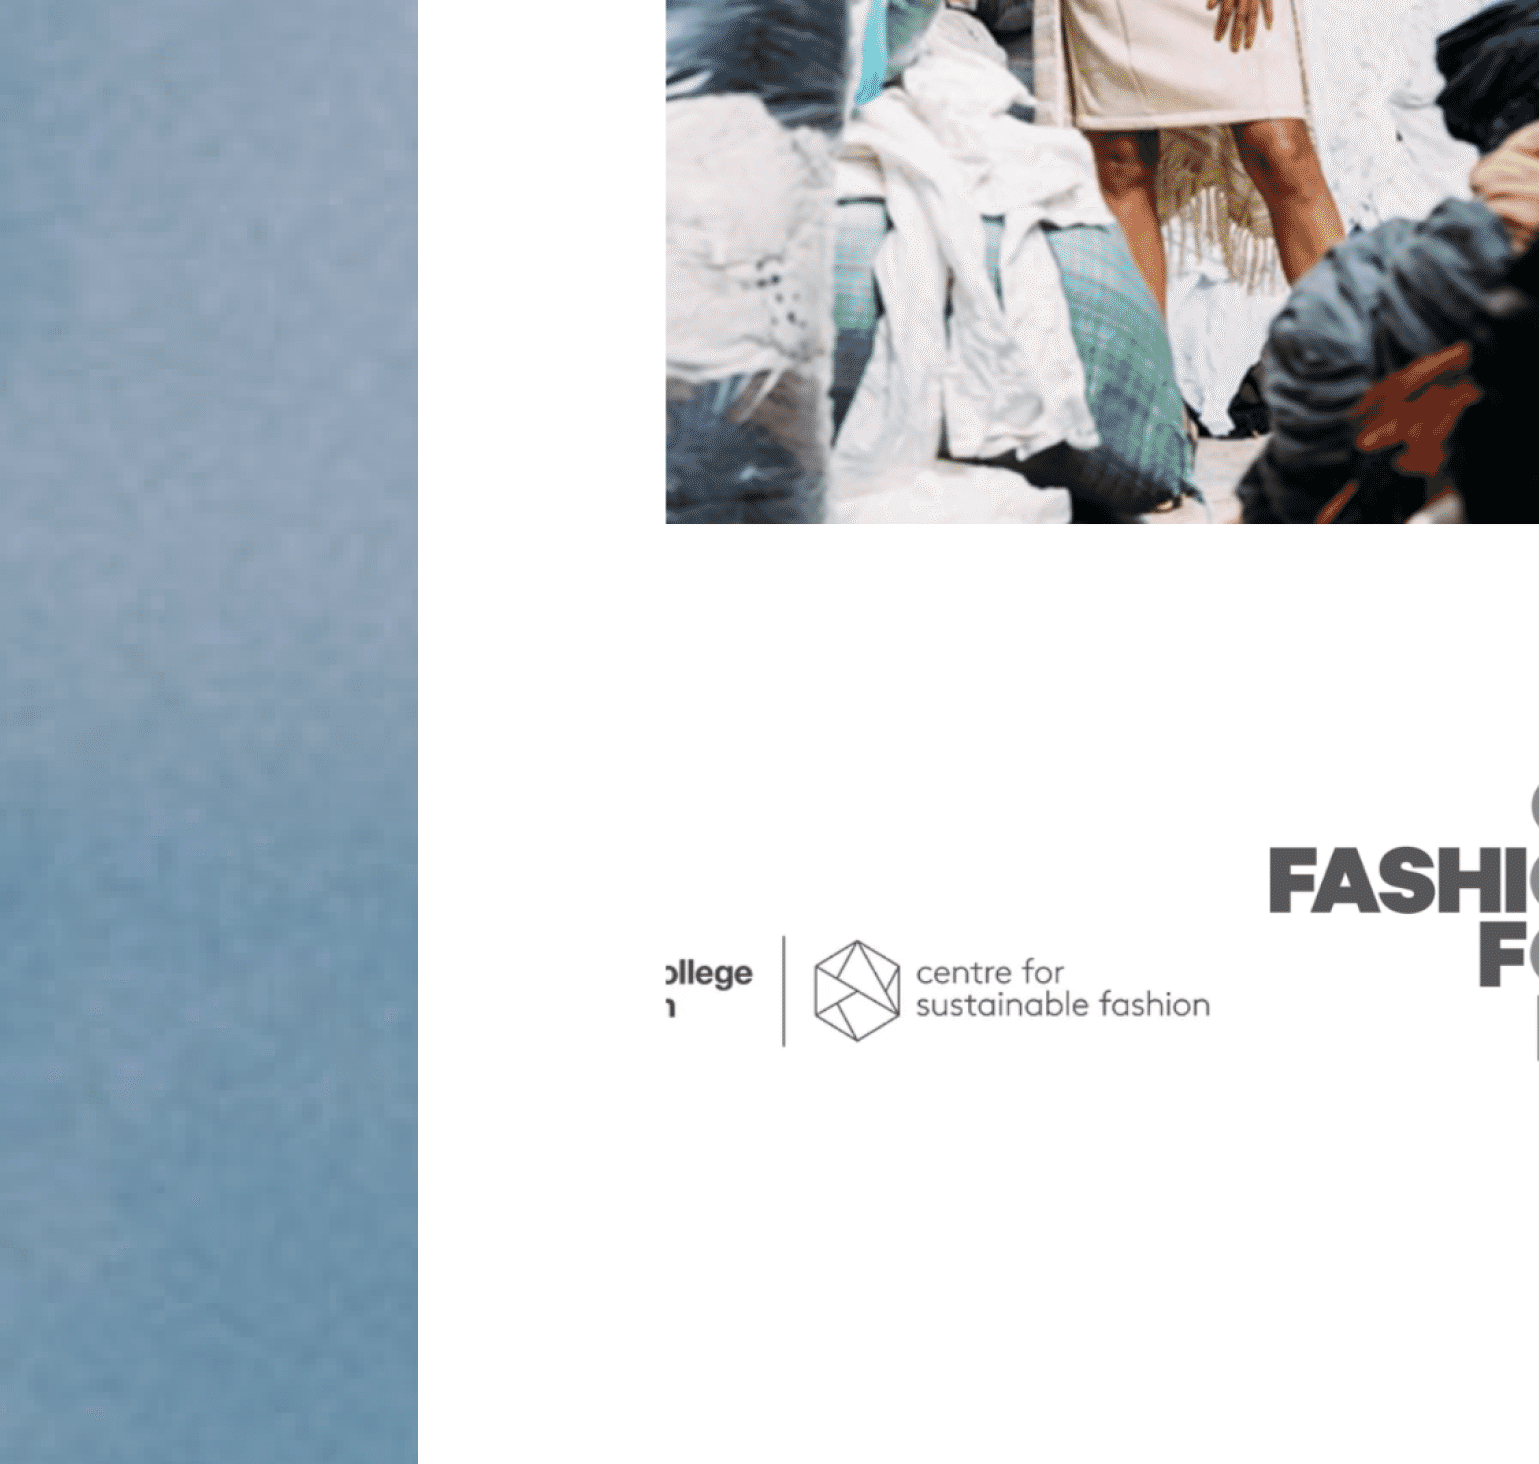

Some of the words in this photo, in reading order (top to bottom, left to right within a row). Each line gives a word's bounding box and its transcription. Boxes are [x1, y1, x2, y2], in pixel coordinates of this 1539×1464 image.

[916, 962, 1012, 985] centre
[1021, 957, 1065, 985] for
[916, 990, 1089, 1017] sustainable
[1098, 989, 1210, 1017] fashion
